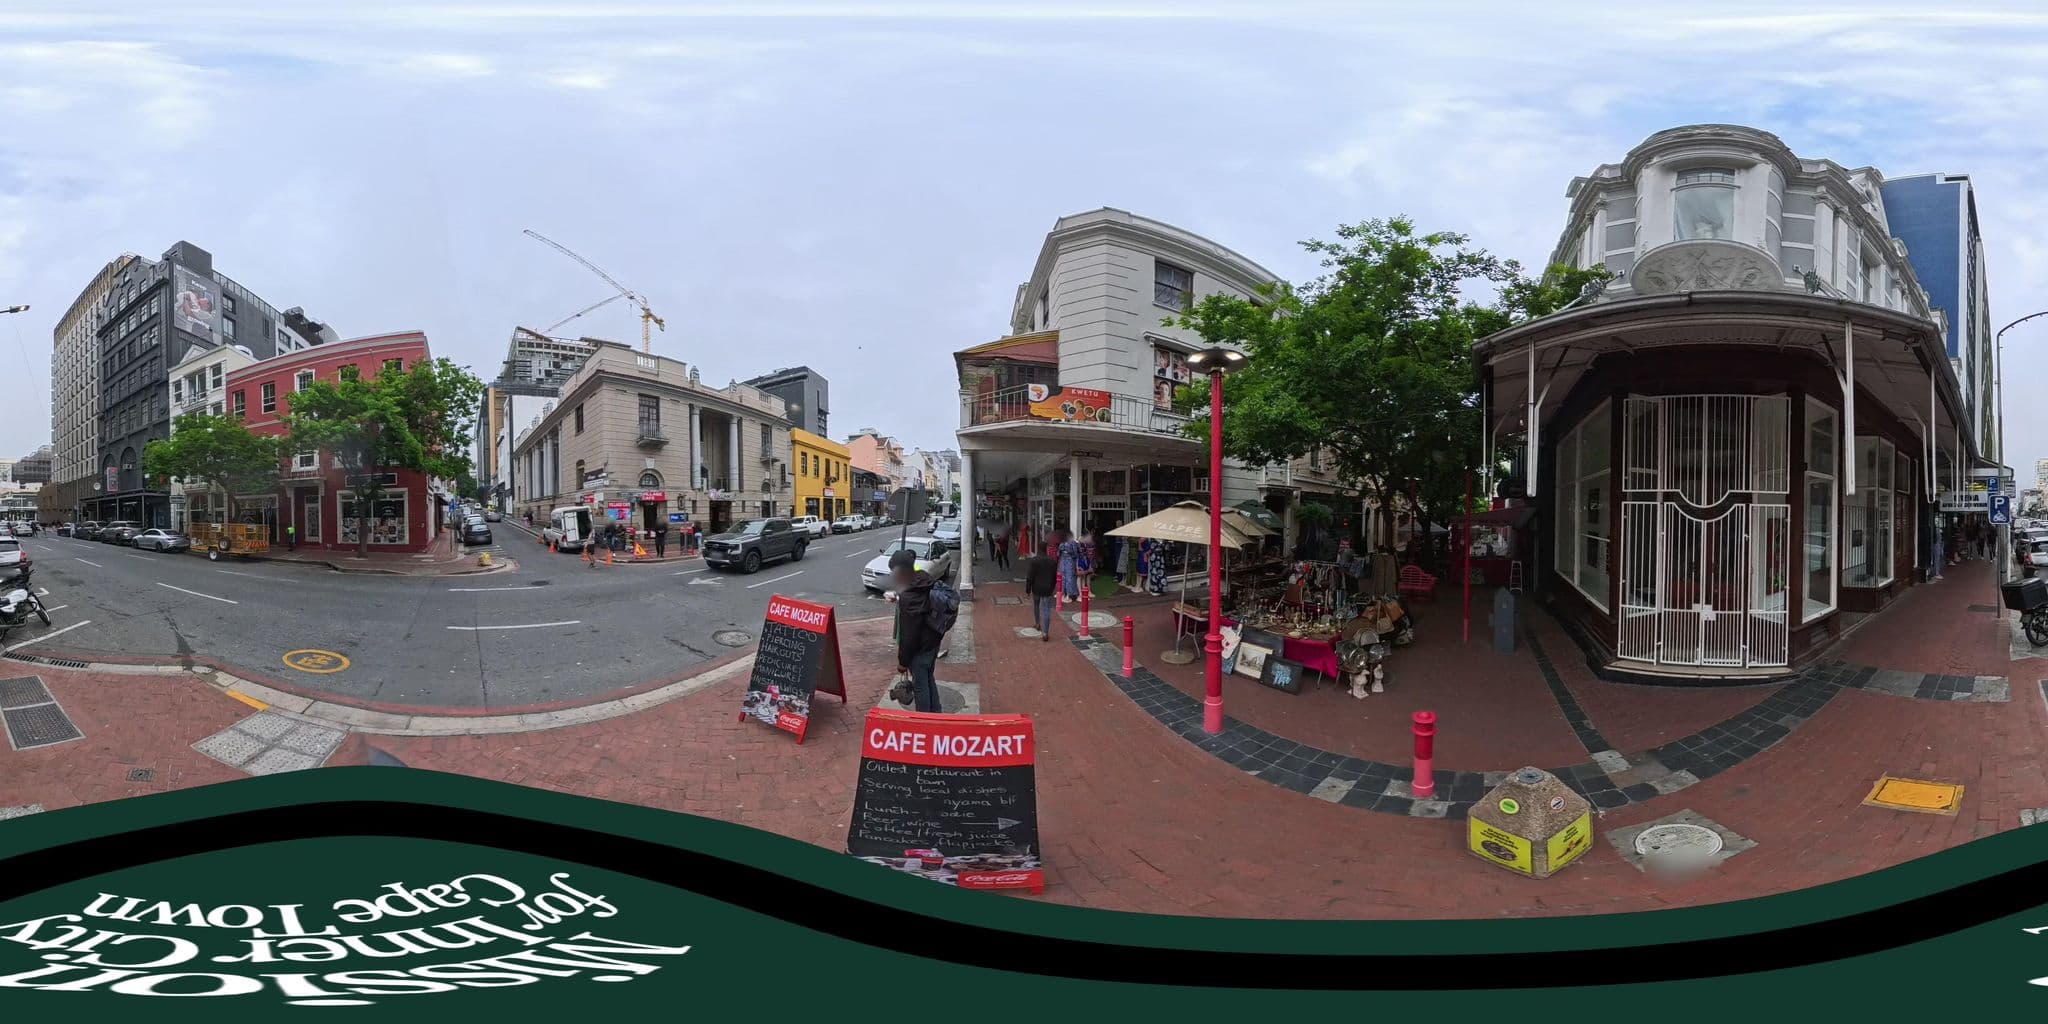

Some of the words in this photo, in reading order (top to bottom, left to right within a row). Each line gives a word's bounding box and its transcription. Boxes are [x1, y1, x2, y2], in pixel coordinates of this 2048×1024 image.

[1071, 388, 1099, 398] KWETU
[1995, 498, 2005, 509] P
[769, 602, 791, 618] CAFE
[790, 607, 826, 626] MOZART
[766, 621, 818, 643] TATTOO
[870, 728, 926, 754] CAFE
[933, 735, 1026, 757] MOZART
[866, 760, 909, 775] Oldest
[916, 767, 984, 777] restaurant
[990, 768, 1003, 777] in
[863, 777, 912, 796] Serving
[919, 785, 951, 794] local
[916, 775, 946, 786] town
